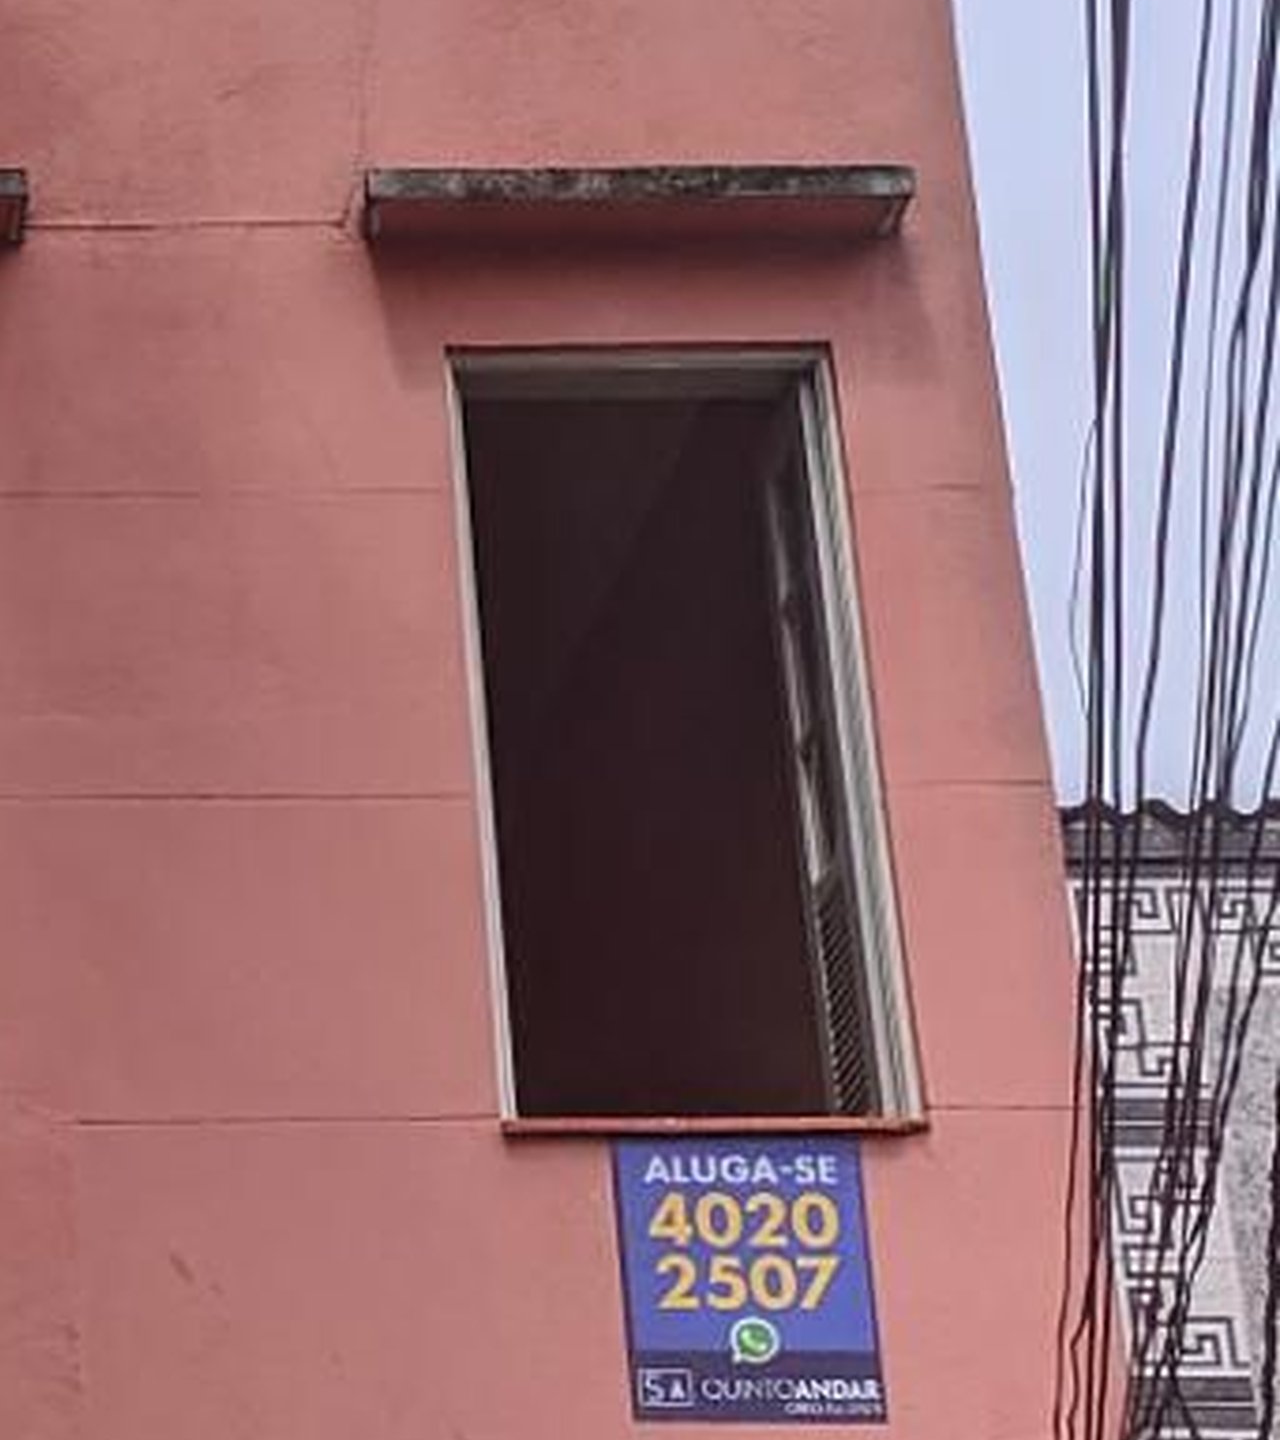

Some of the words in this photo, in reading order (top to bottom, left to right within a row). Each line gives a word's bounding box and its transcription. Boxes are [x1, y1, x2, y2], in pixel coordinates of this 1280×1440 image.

[643, 1154, 839, 1185] ALUGA-SE
[648, 1191, 840, 1249] 4020
[655, 1254, 841, 1311] 2507
